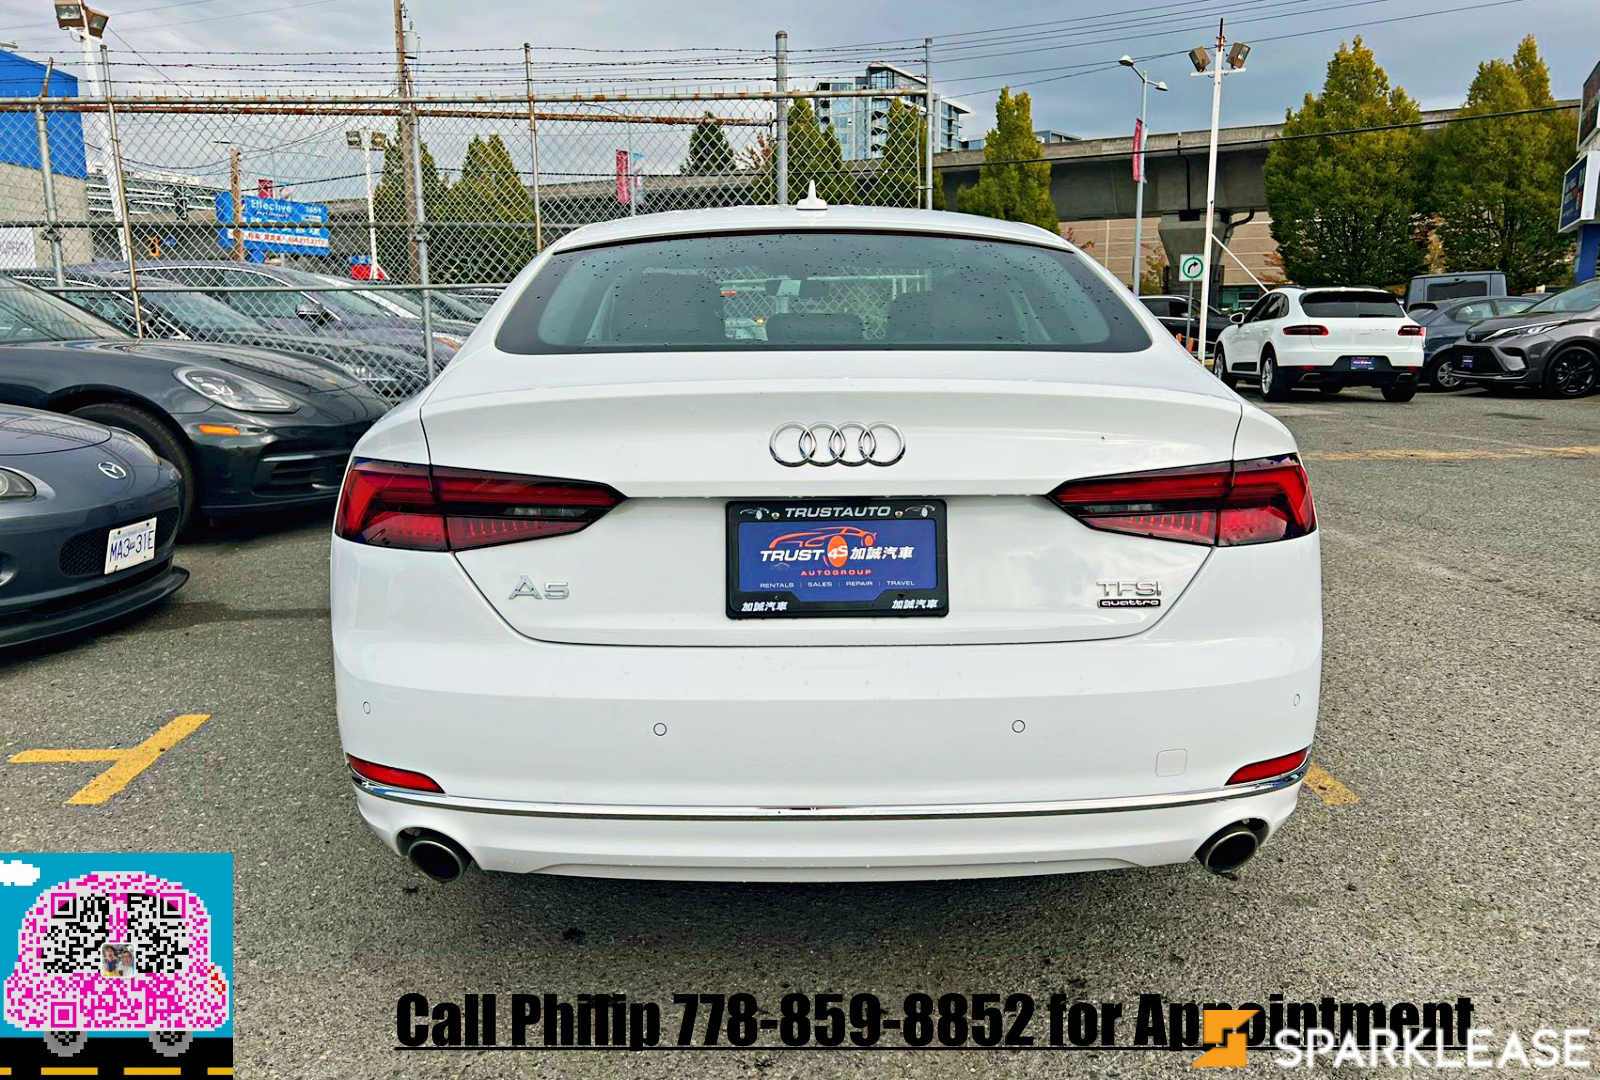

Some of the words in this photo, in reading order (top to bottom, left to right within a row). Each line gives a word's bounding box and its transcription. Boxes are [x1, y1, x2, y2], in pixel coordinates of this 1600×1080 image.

[785, 506, 891, 518] TRUSTAUTO
[760, 550, 825, 562] TRUST
[850, 546, 915, 560] 加誠汽車
[801, 569, 872, 577] AUTOGROUP
[508, 575, 570, 600] A5
[1101, 600, 1160, 608] quattro
